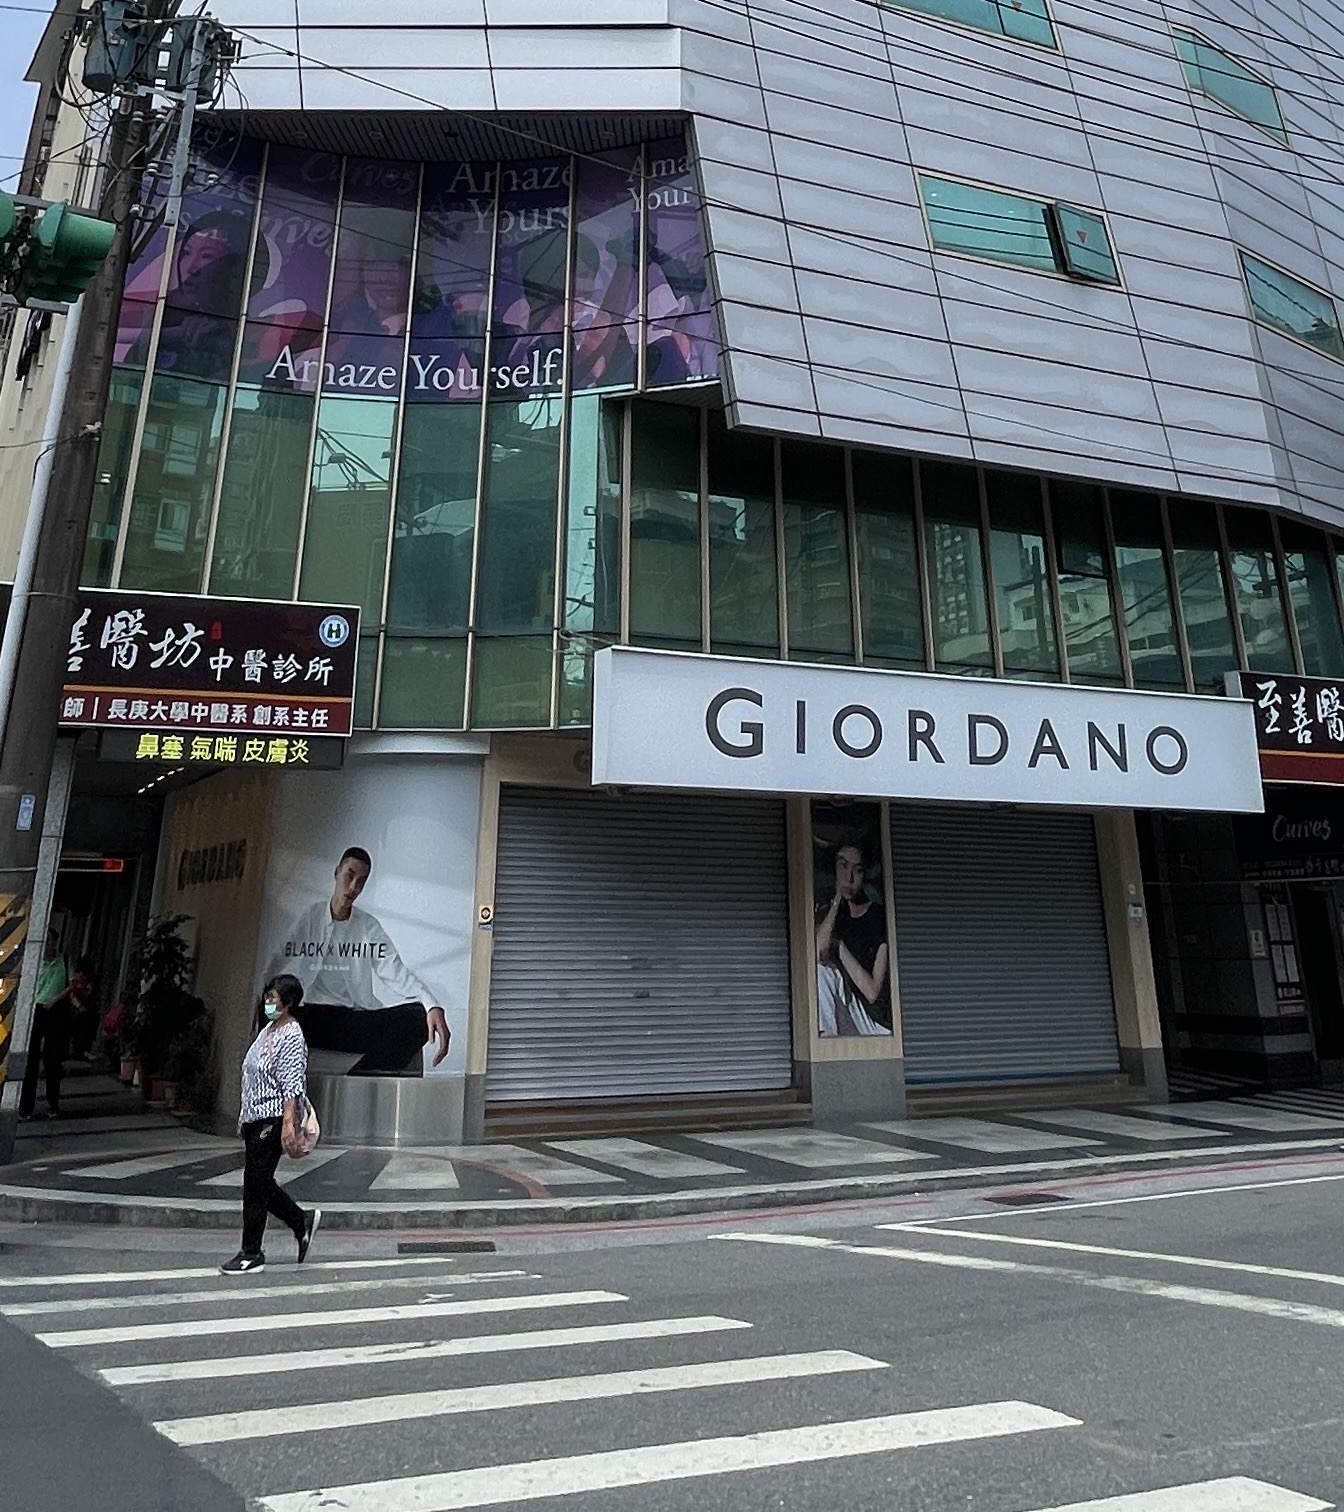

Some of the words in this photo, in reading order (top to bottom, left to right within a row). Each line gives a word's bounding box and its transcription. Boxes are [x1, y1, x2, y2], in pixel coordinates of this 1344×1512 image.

[264, 344, 398, 390] Amaze
[409, 348, 564, 390] Youself.
[209, 647, 334, 686] 中醫診所
[107, 698, 249, 725] 長庚大學中醫系
[252, 704, 329, 728] 創系主任
[705, 686, 1189, 776] GIORDANO
[135, 732, 185, 760] 鼻塞
[190, 735, 238, 763] 氣喘
[242, 738, 311, 765] 皮膚炎
[284, 941, 325, 958] BLACK
[338, 942, 389, 959] WHITE
